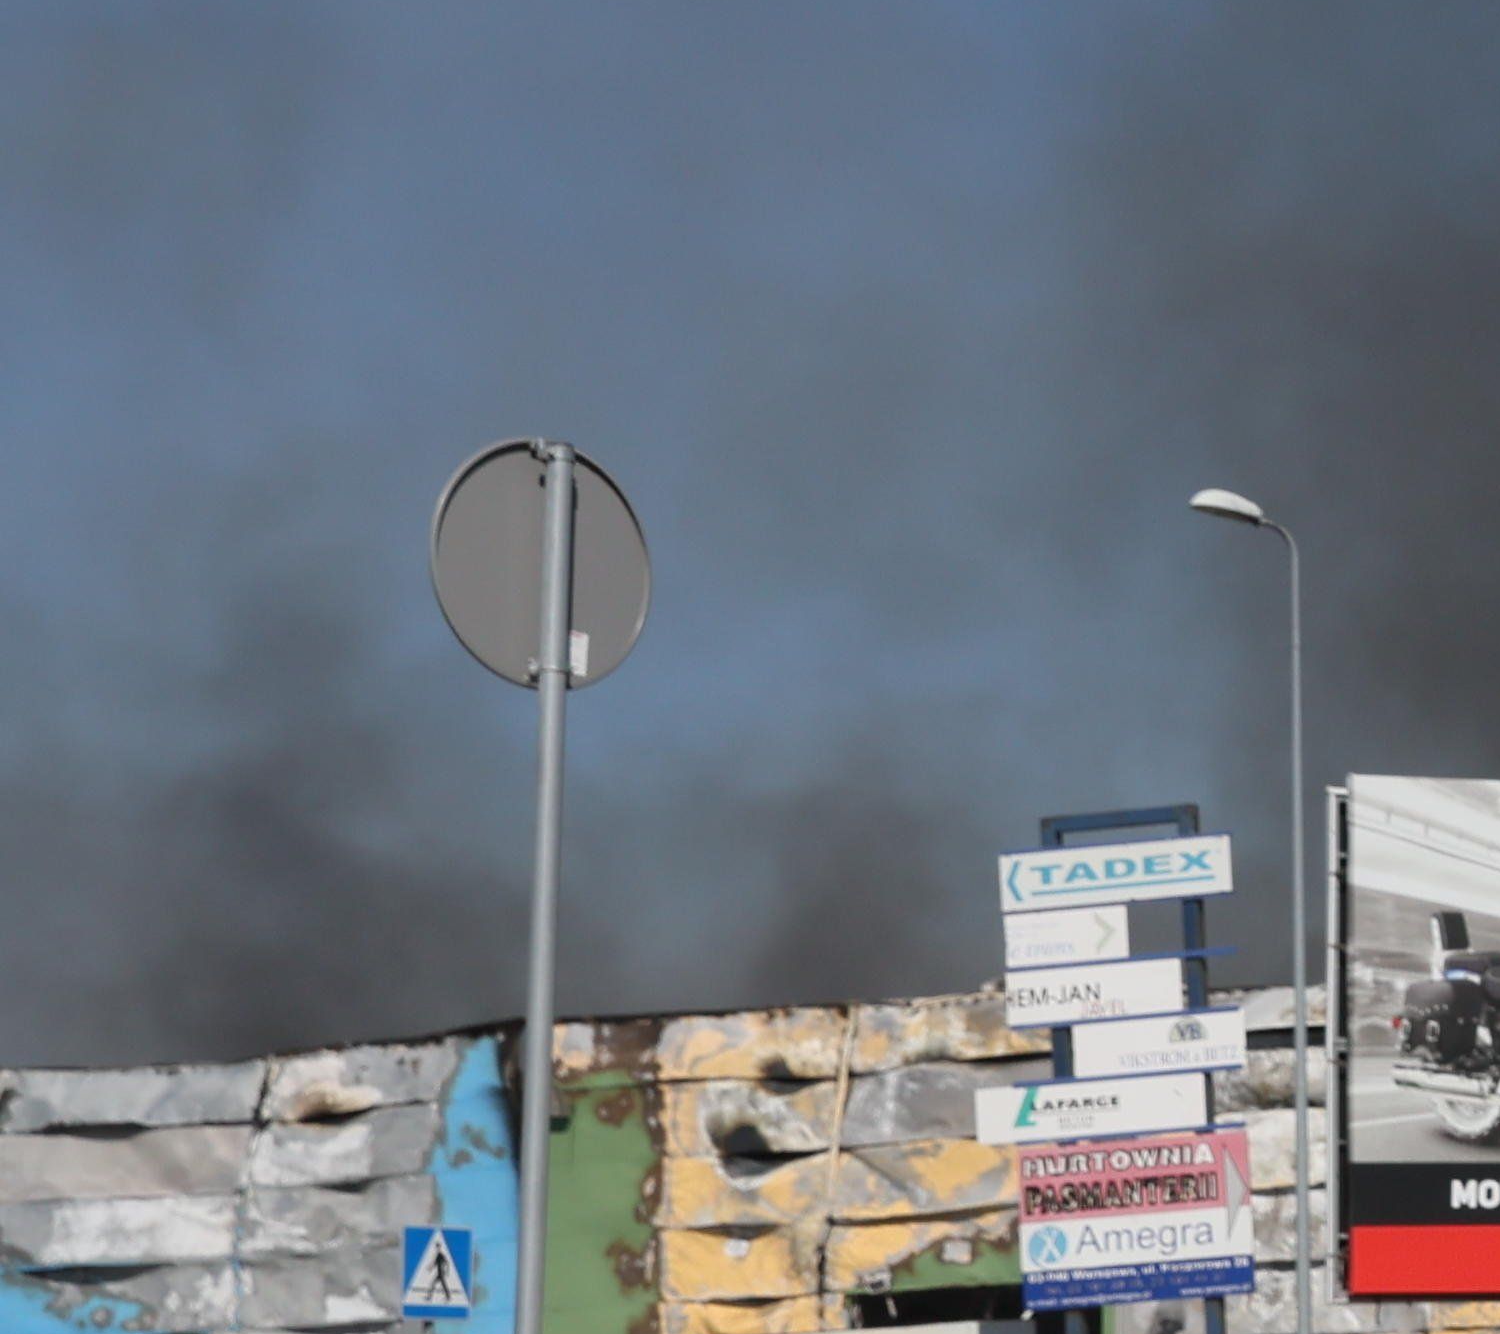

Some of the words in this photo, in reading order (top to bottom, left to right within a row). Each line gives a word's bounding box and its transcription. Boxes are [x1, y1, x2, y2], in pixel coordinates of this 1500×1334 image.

[1031, 851, 1212, 885] TADEX
[1023, 1143, 1214, 1178] HURTOWNIA
[1024, 1172, 1217, 1216] PASMANTERII
[1076, 1220, 1214, 1255] Amegra
